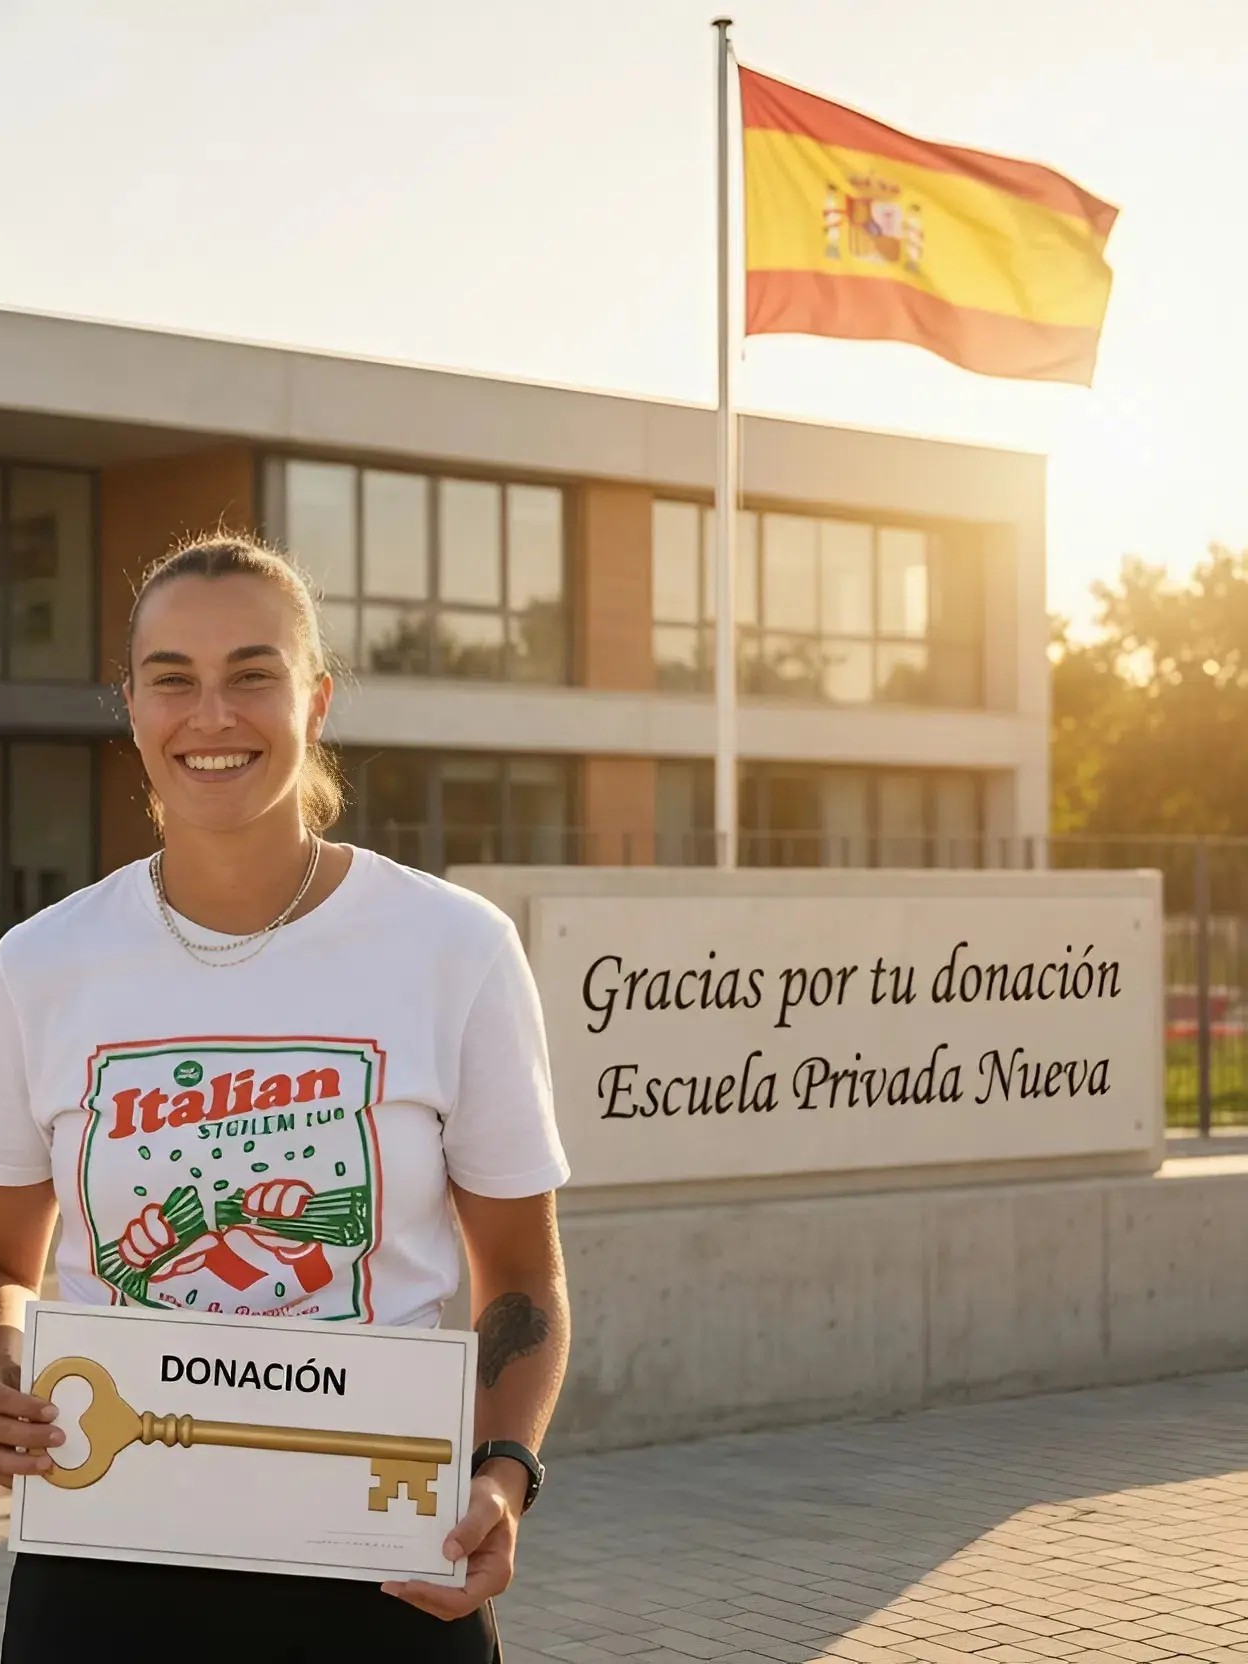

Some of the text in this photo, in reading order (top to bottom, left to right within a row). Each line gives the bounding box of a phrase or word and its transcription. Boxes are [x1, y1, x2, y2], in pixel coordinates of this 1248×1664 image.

[583, 941, 1122, 1034] Gracias por tu donación
[108, 1068, 341, 1140] Italian
[597, 1043, 1111, 1120] Escuela Privada Nueva
[160, 1354, 347, 1396] DONACIÓN
